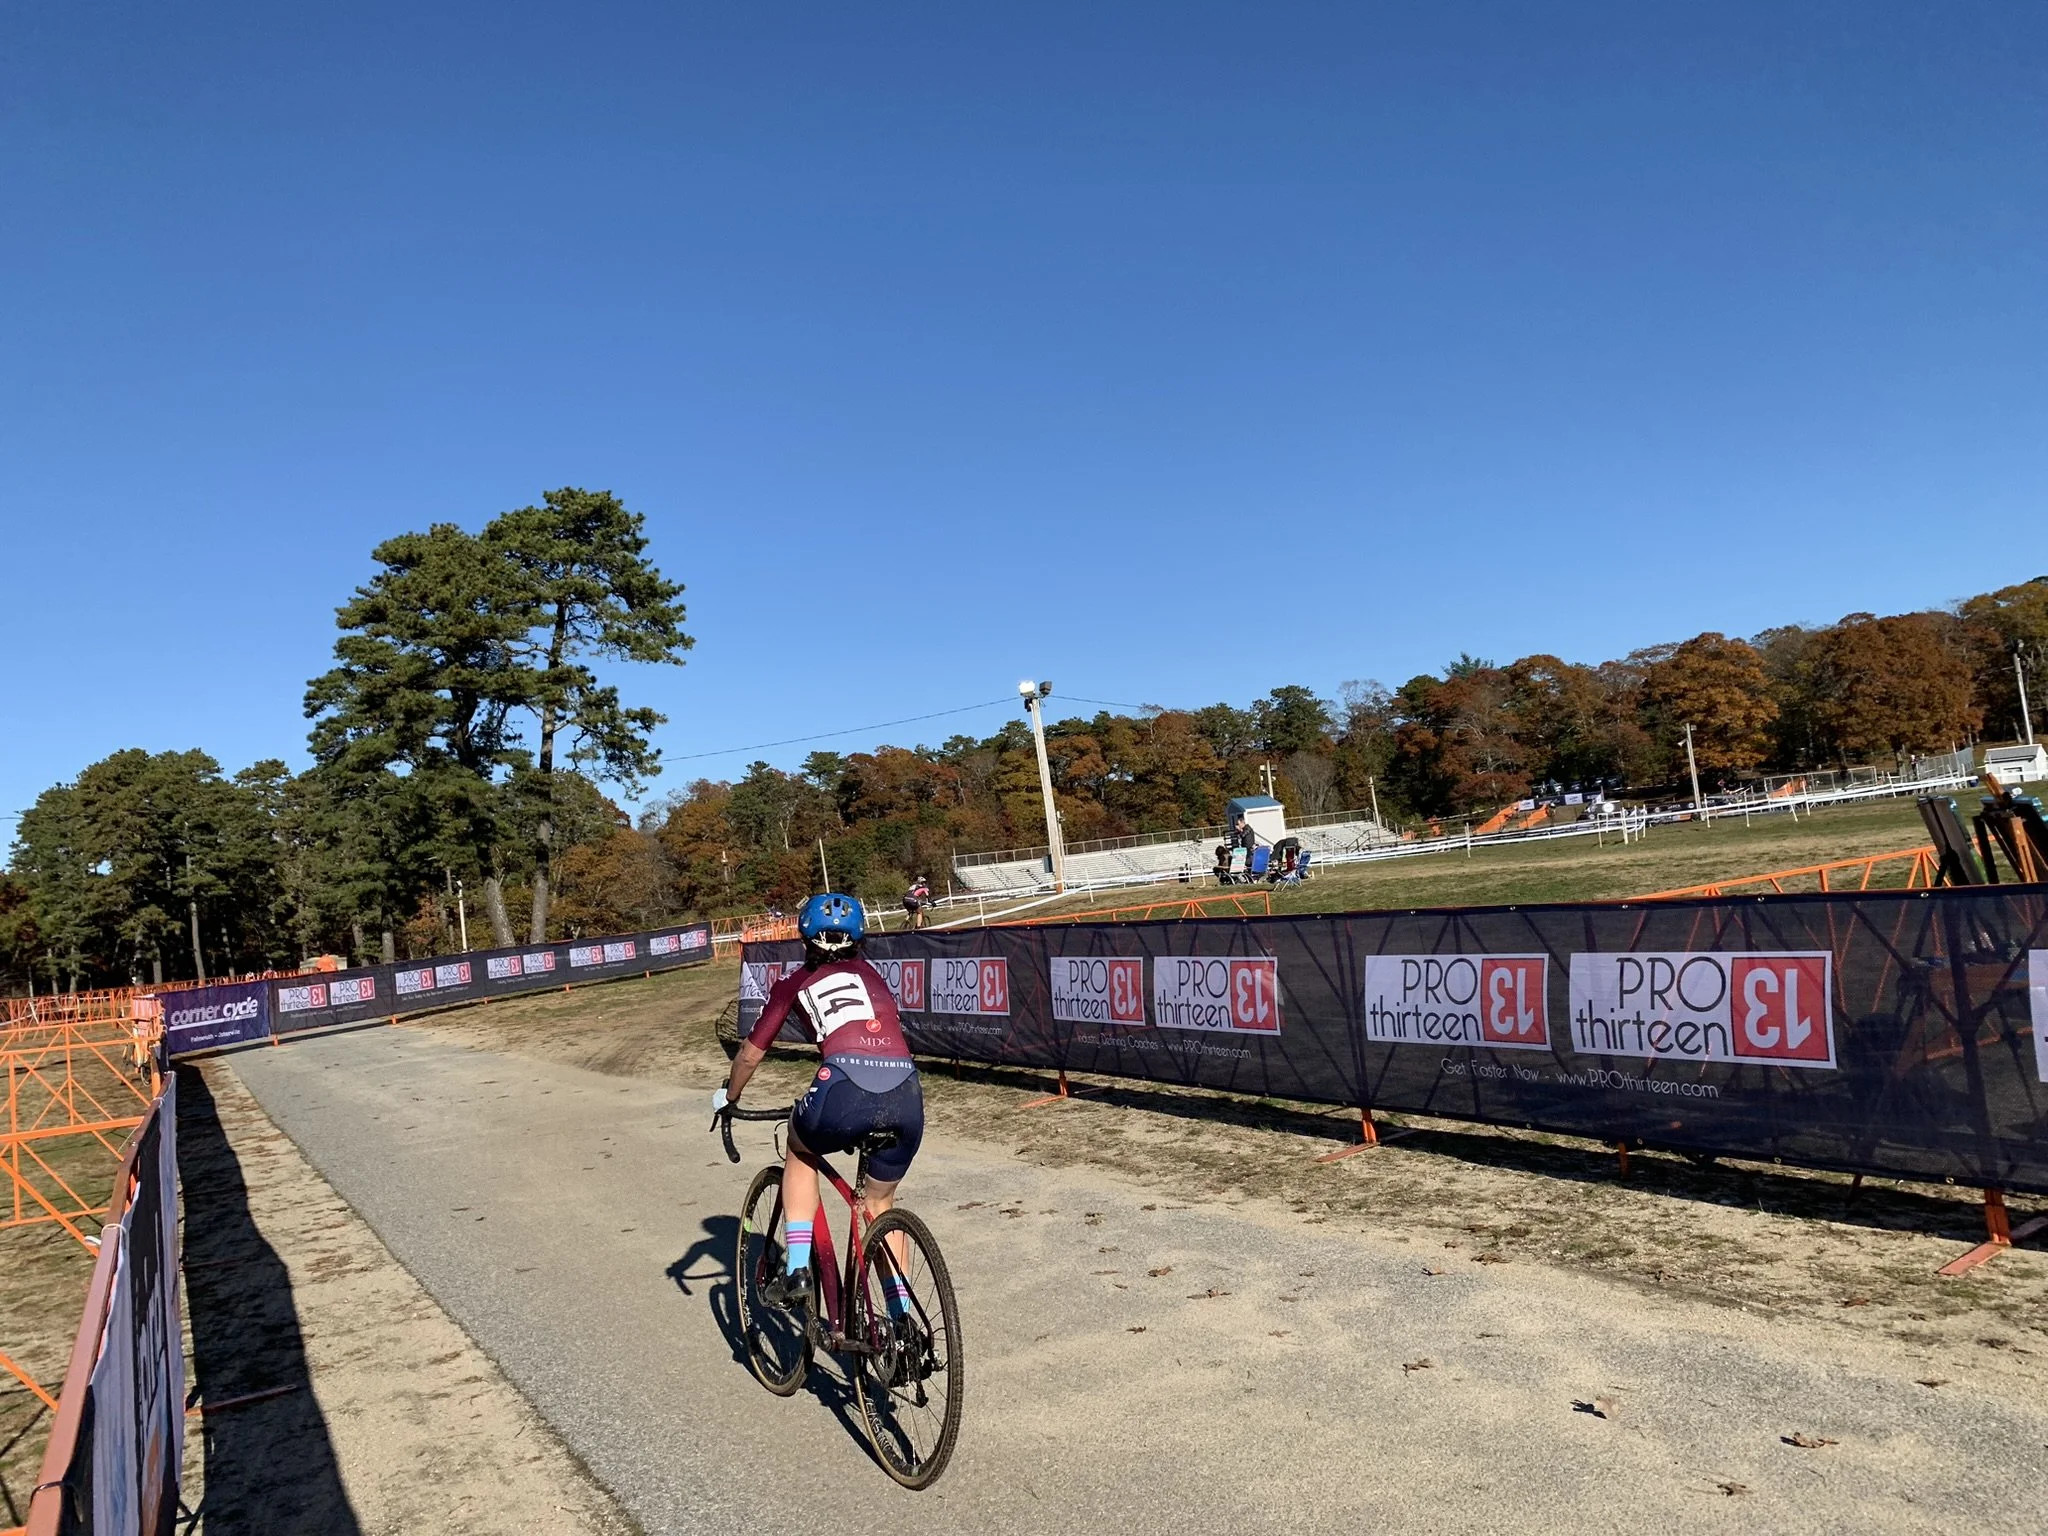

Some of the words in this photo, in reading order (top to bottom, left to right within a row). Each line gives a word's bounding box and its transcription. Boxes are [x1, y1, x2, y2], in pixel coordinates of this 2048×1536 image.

[339, 980, 359, 992] PRO
[361, 980, 373, 997] 13
[403, 971, 420, 984] PRO
[904, 966, 920, 1004] 13
[946, 960, 978, 989] PRO
[983, 965, 1004, 1007] 13
[1068, 959, 1108, 994] PRO
[1113, 966, 1137, 1015] 13
[1176, 959, 1228, 998] PRO
[1401, 957, 1478, 1005] PRO
[1616, 955, 1727, 1013] PRO
[170, 1004, 220, 1026] corner
[222, 996, 259, 1020] cycle
[280, 998, 310, 1011] thirteen
[288, 987, 310, 1000] PRO
[312, 987, 324, 1004] 13
[818, 983, 864, 1016] 14
[932, 984, 979, 1011] thirteen
[1054, 986, 1110, 1020] thirteen
[1157, 989, 1231, 1028] thirteen
[1236, 967, 1269, 1023] 13
[1489, 967, 1534, 1035] 13
[1743, 967, 1812, 1049] 13
[1370, 994, 1481, 1041] thirteen
[1576, 999, 1729, 1056] thirteen
[860, 1036, 891, 1047] MDC
[1127, 1034, 1159, 1050] Coaches
[1167, 1039, 1252, 1059] www.PROthirteen.com
[1440, 1057, 1466, 1075] Get
[1471, 1059, 1508, 1079] Faster
[1512, 1063, 1540, 1081] Now
[1555, 1068, 1719, 1098] www.PROthirteen.com
